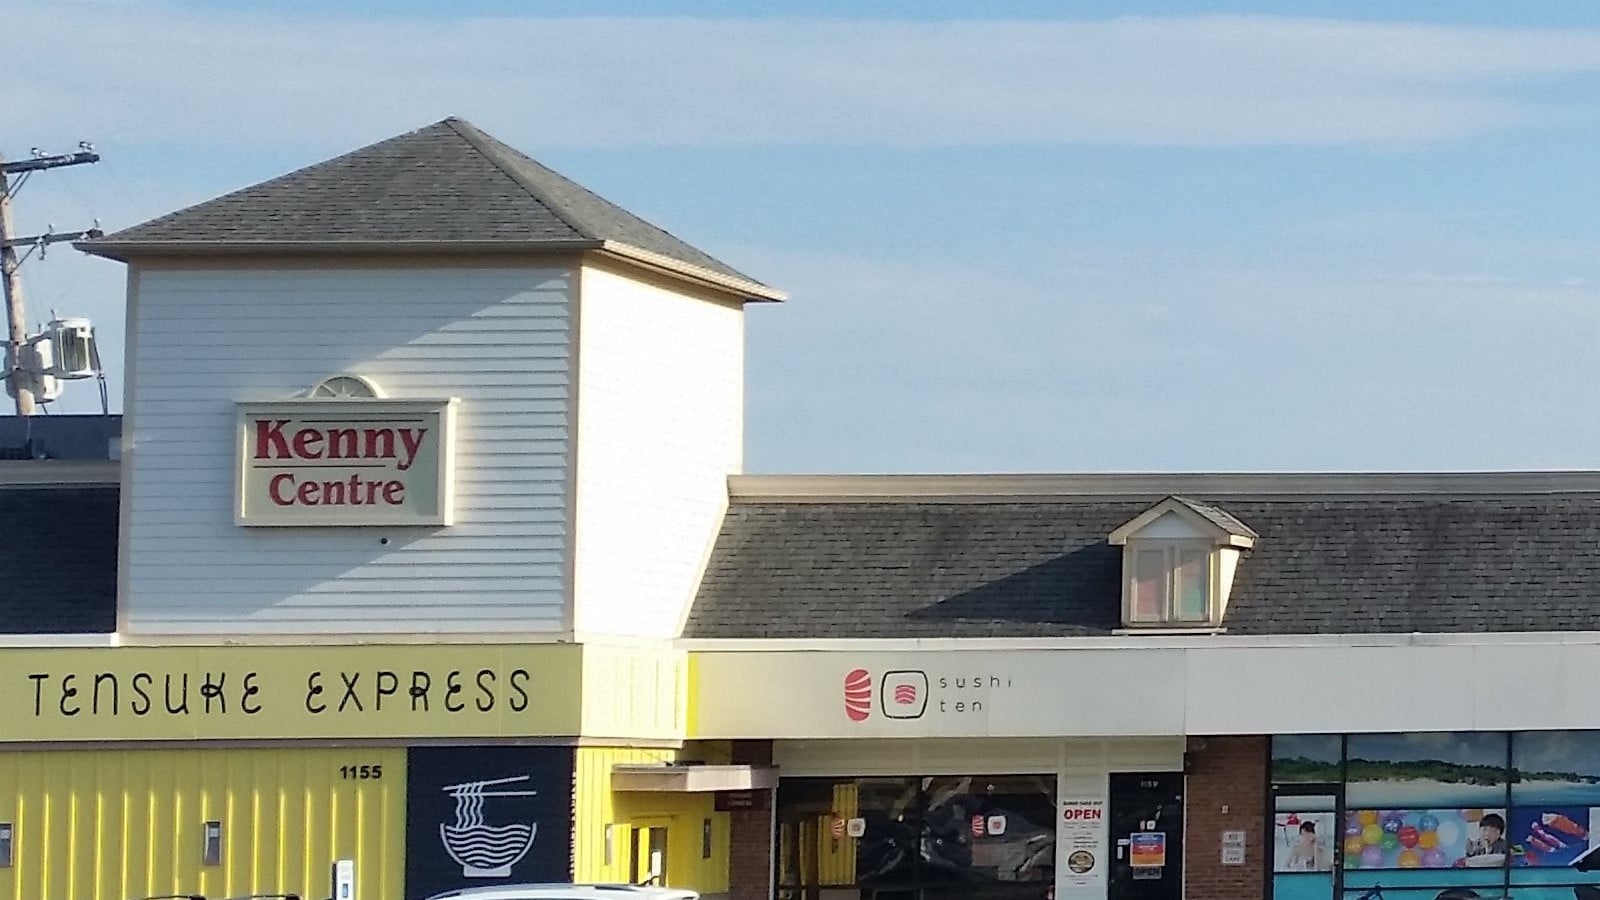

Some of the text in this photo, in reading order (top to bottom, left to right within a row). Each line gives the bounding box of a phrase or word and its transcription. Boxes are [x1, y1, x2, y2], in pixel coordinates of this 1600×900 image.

[254, 419, 428, 471] Kenny
[269, 473, 405, 506] Centre
[939, 675, 1012, 689] sushi
[29, 669, 530, 716] TENSUKE EXPRESS
[940, 700, 982, 712] ten
[340, 765, 382, 779] 1155
[1063, 808, 1102, 820] OPEN
